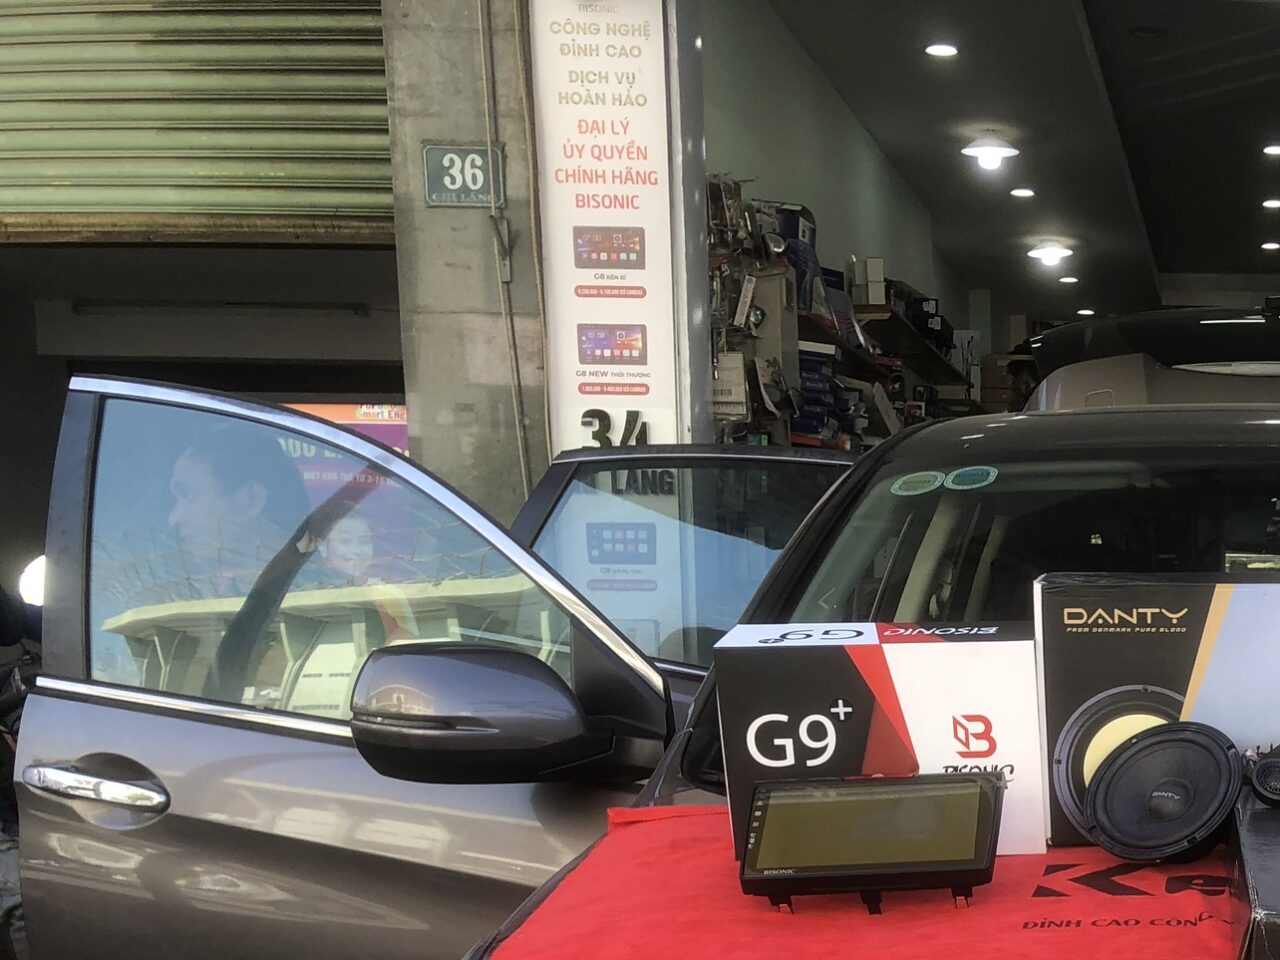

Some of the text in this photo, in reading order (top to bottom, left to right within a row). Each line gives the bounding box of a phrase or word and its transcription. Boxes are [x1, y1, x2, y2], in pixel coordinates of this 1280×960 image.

[550, 19, 651, 40] CÔNG NGHỆ
[559, 39, 642, 58] ĐỈNH CAO
[568, 70, 636, 88] DỊCH VỤ
[558, 89, 648, 107] HOÀN HẢO
[577, 117, 630, 138] ĐẠI LÝ
[563, 139, 648, 161] ỦY QUYỀN
[442, 153, 484, 191] 36
[554, 167, 659, 187] CHÍNH HÃNG
[575, 193, 640, 210] BISONIC
[588, 370, 609, 378] NEW
[581, 408, 648, 449] 34
[1064, 608, 1188, 624] DANTY
[883, 626, 999, 637] BISONIC
[1090, 918, 1141, 928] CAO
